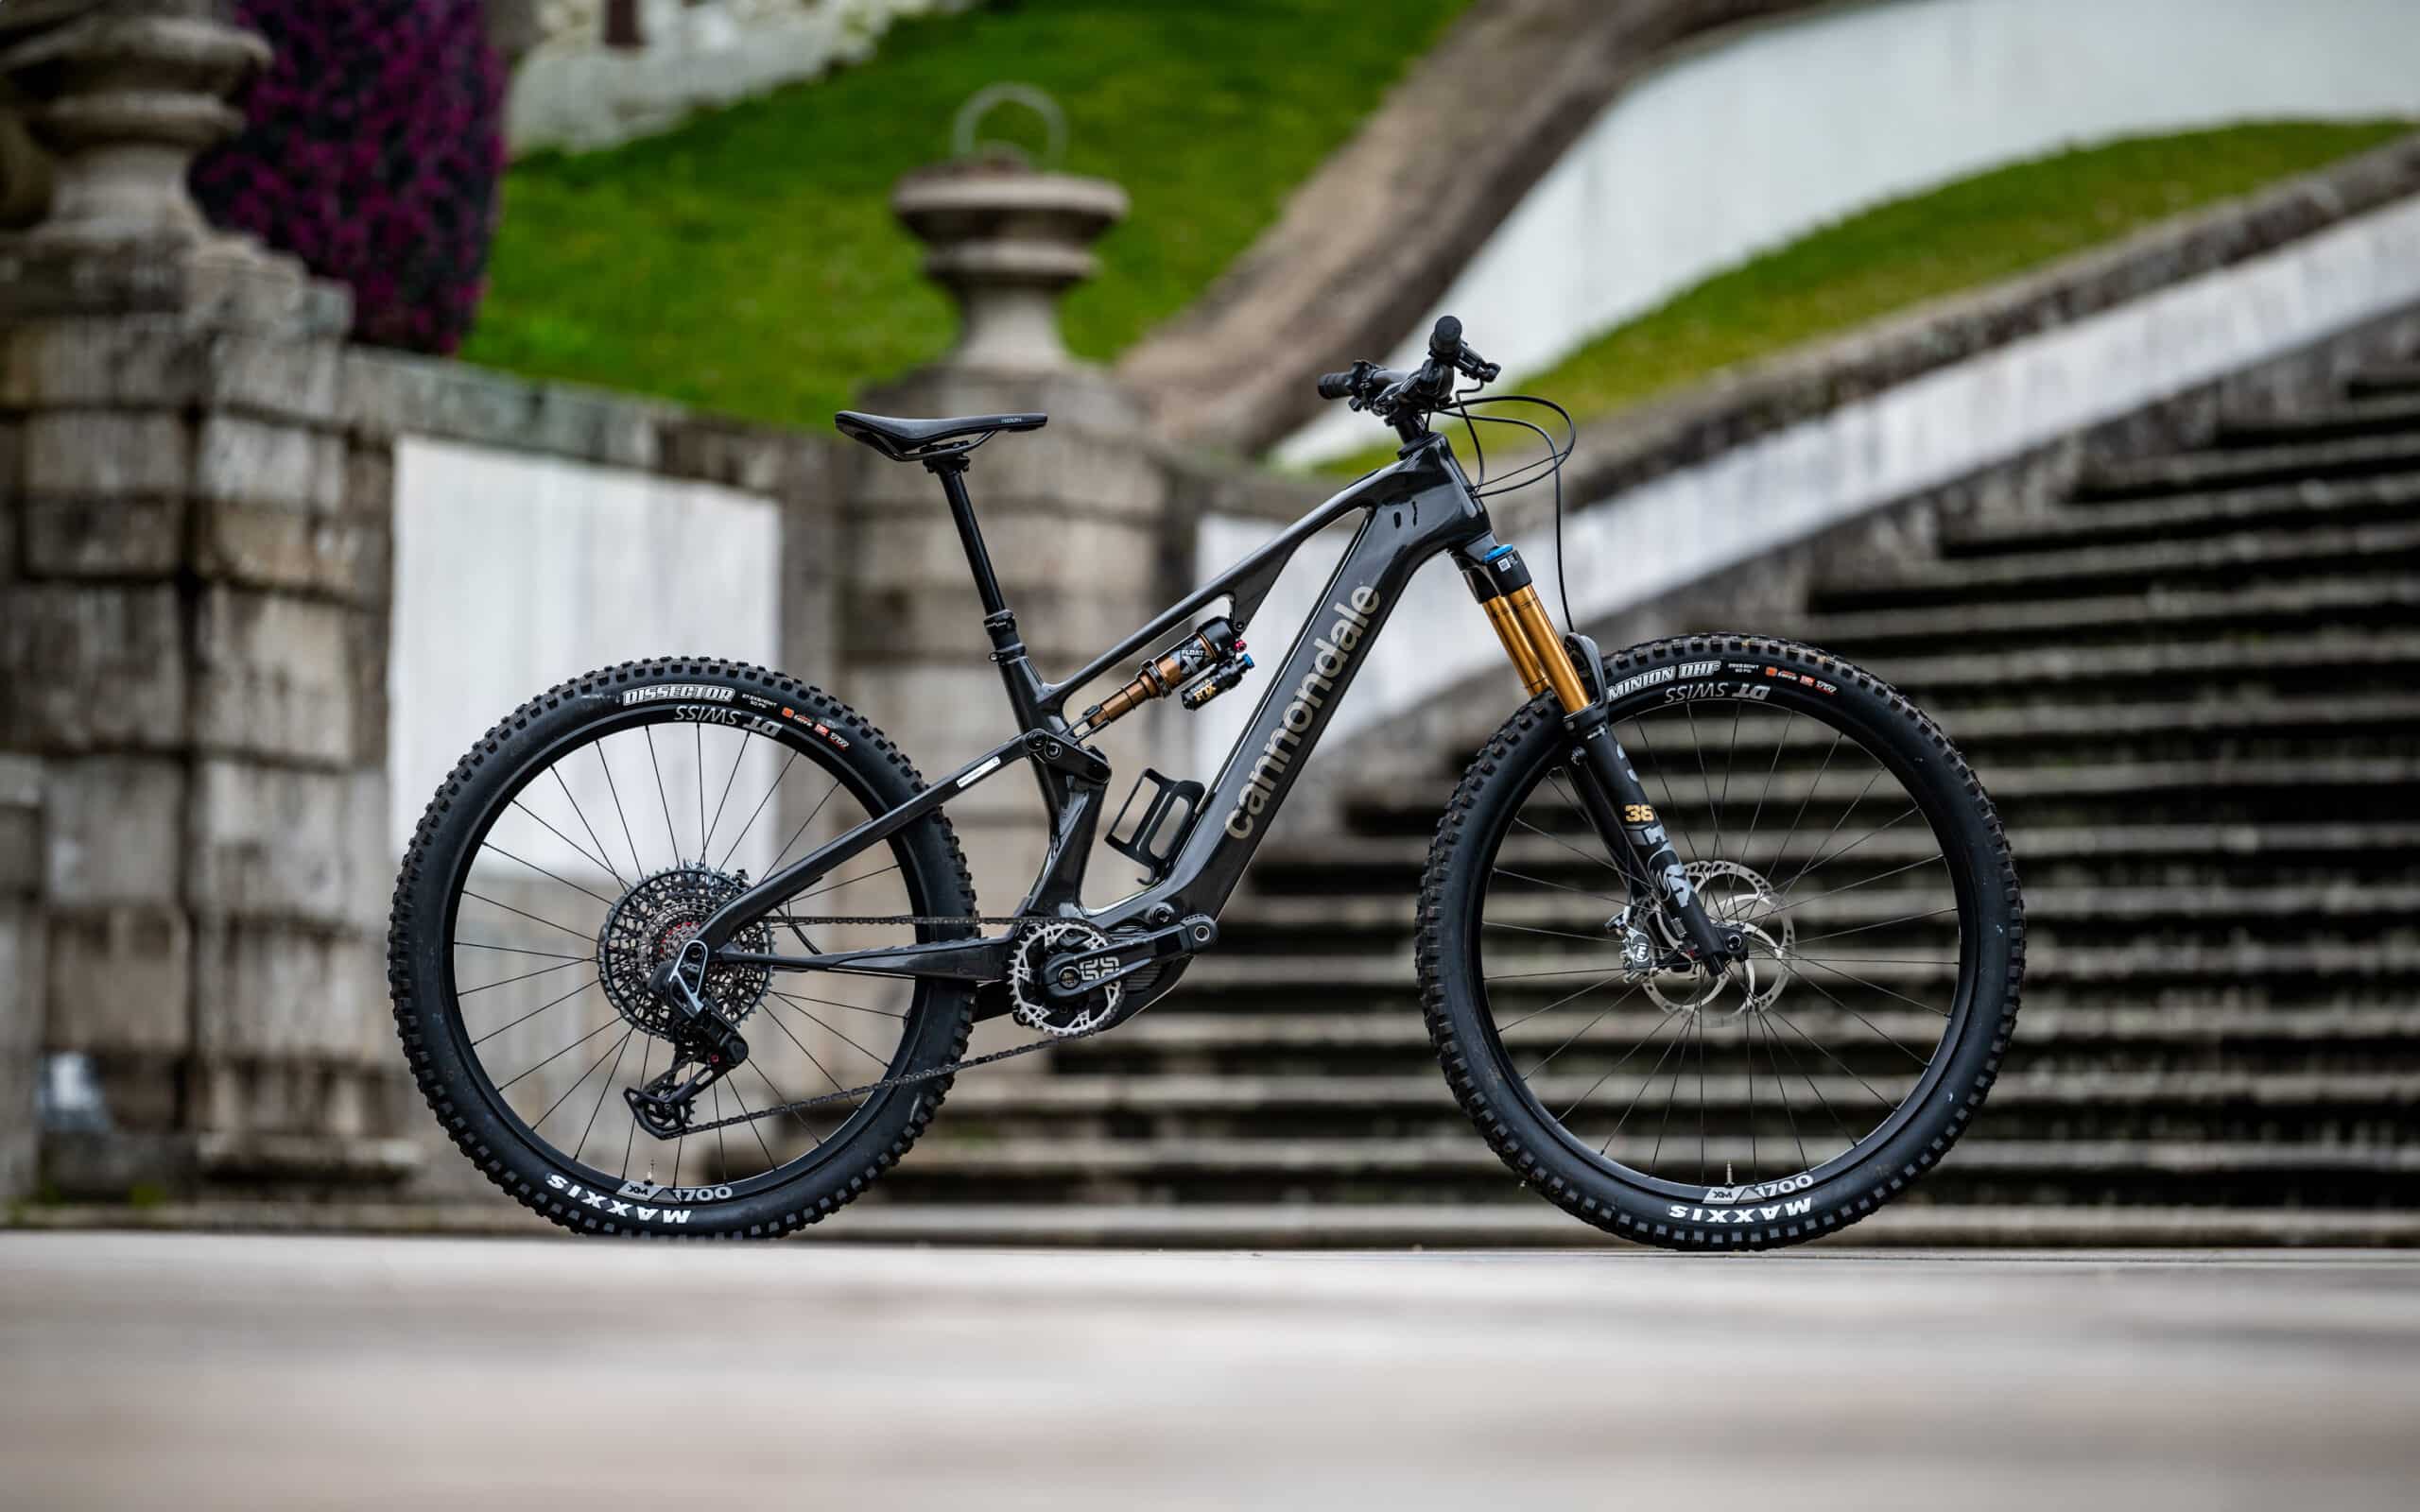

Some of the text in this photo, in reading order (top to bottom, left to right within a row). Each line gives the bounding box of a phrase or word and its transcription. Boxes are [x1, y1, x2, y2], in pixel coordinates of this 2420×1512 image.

[1607, 666, 1676, 702] MINION
[1678, 660, 1721, 679] DHF
[1665, 681, 1771, 704] DT SWISS
[622, 683, 735, 706] DISSECTOR
[673, 704, 741, 726] SWISS
[1225, 585, 1380, 839] cannondale
[742, 715, 783, 737] DT
[1625, 805, 1654, 822] 36
[673, 1186, 733, 1201] 1700
[1754, 1175, 1814, 1198] 1700
[545, 1174, 691, 1224] MAXXIS
[1668, 1196, 1812, 1224] MAXXIS
